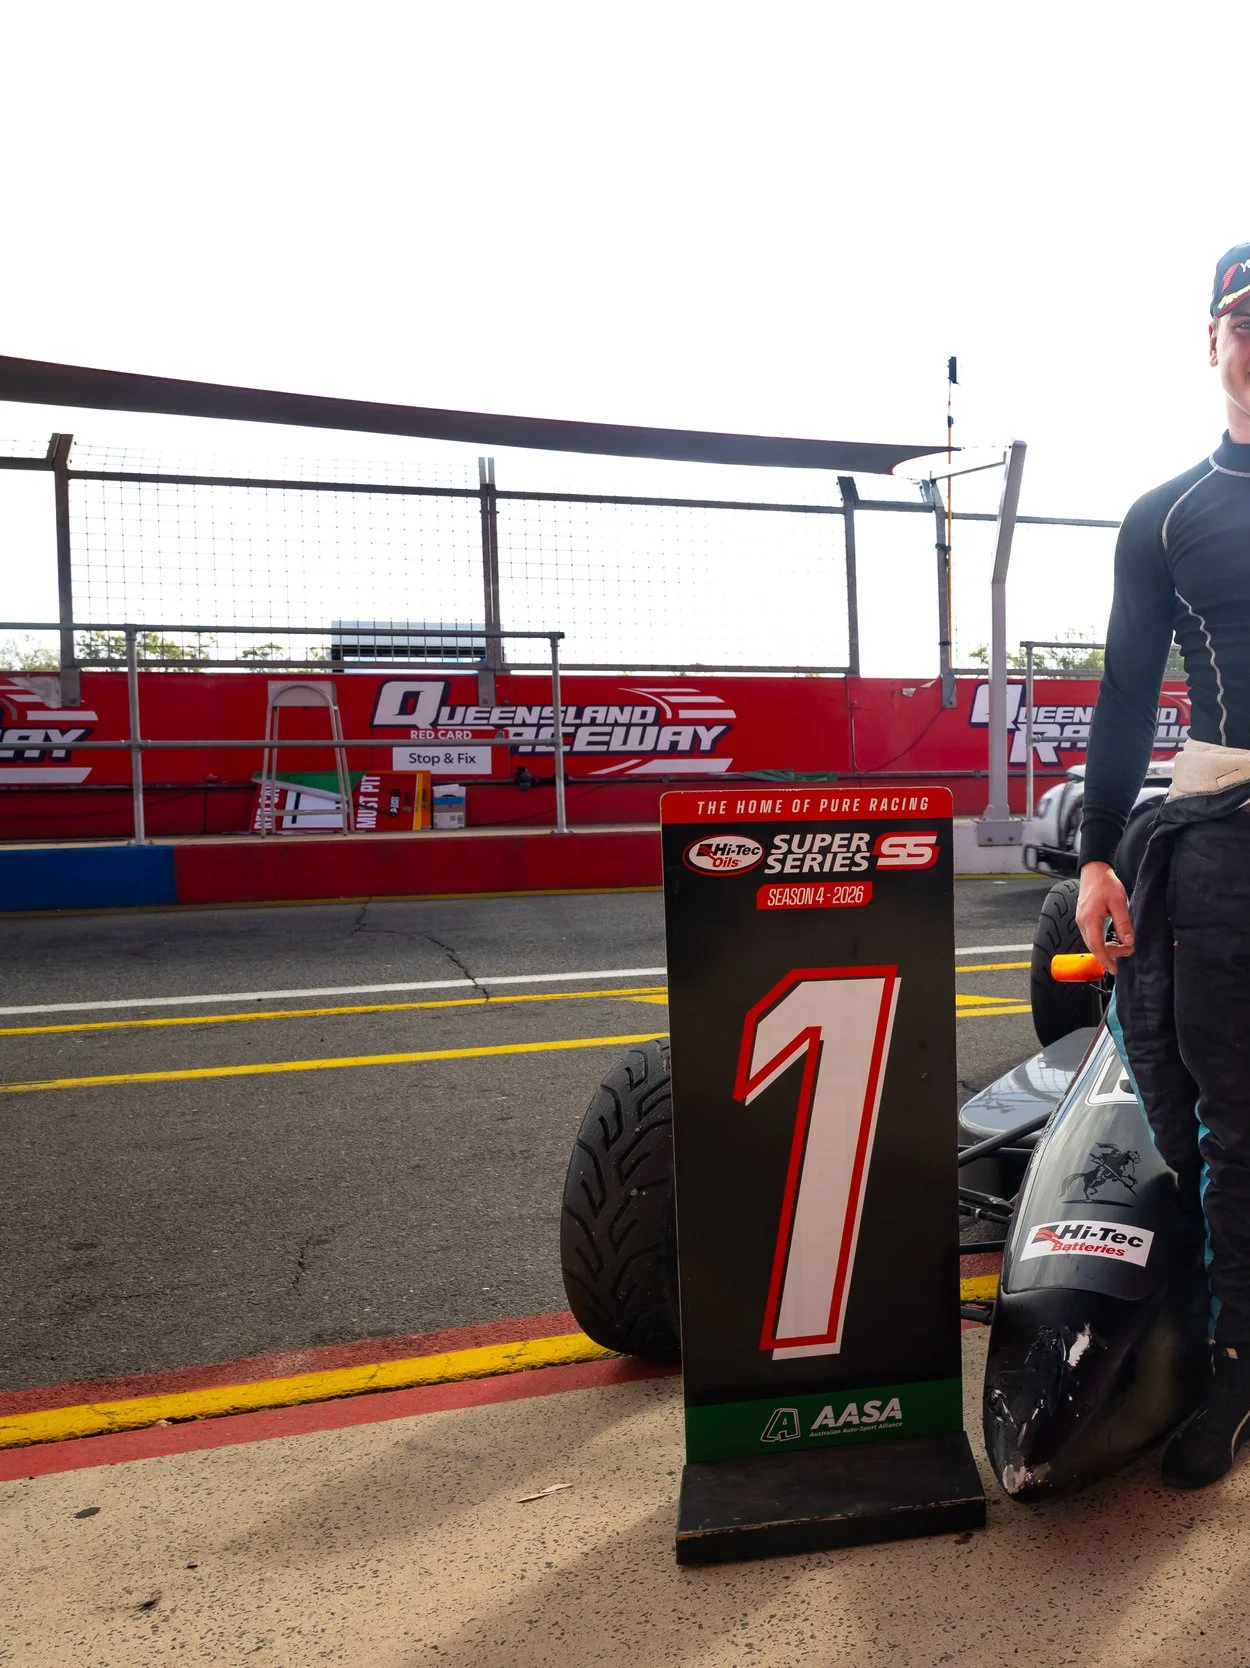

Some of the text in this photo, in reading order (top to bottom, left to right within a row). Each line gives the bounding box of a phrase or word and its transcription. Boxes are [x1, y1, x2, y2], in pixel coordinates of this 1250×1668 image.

[373, 681, 657, 730] QUEENSLAND
[411, 731, 472, 740] RED CARD
[508, 725, 727, 752] ACEWAY
[409, 753, 476, 766] Stop & Fix
[356, 774, 381, 829] MUST PIT
[697, 797, 929, 814] THE HOME OF PURE RACING
[713, 843, 761, 856] Hi-Tec
[771, 832, 871, 854] SUPER
[711, 857, 740, 868] Oils
[764, 851, 870, 874] SERIES
[767, 887, 815, 906] SEASON
[815, 886, 825, 904] 4
[832, 885, 865, 904] 2026
[732, 965, 902, 1360] 1
[1058, 1224, 1144, 1248] Hi-Tec
[1051, 1242, 1126, 1257] Batteries
[810, 1398, 903, 1430] AASA
[809, 1429, 841, 1437] Australian
[842, 1424, 877, 1433] Auto-Sport
